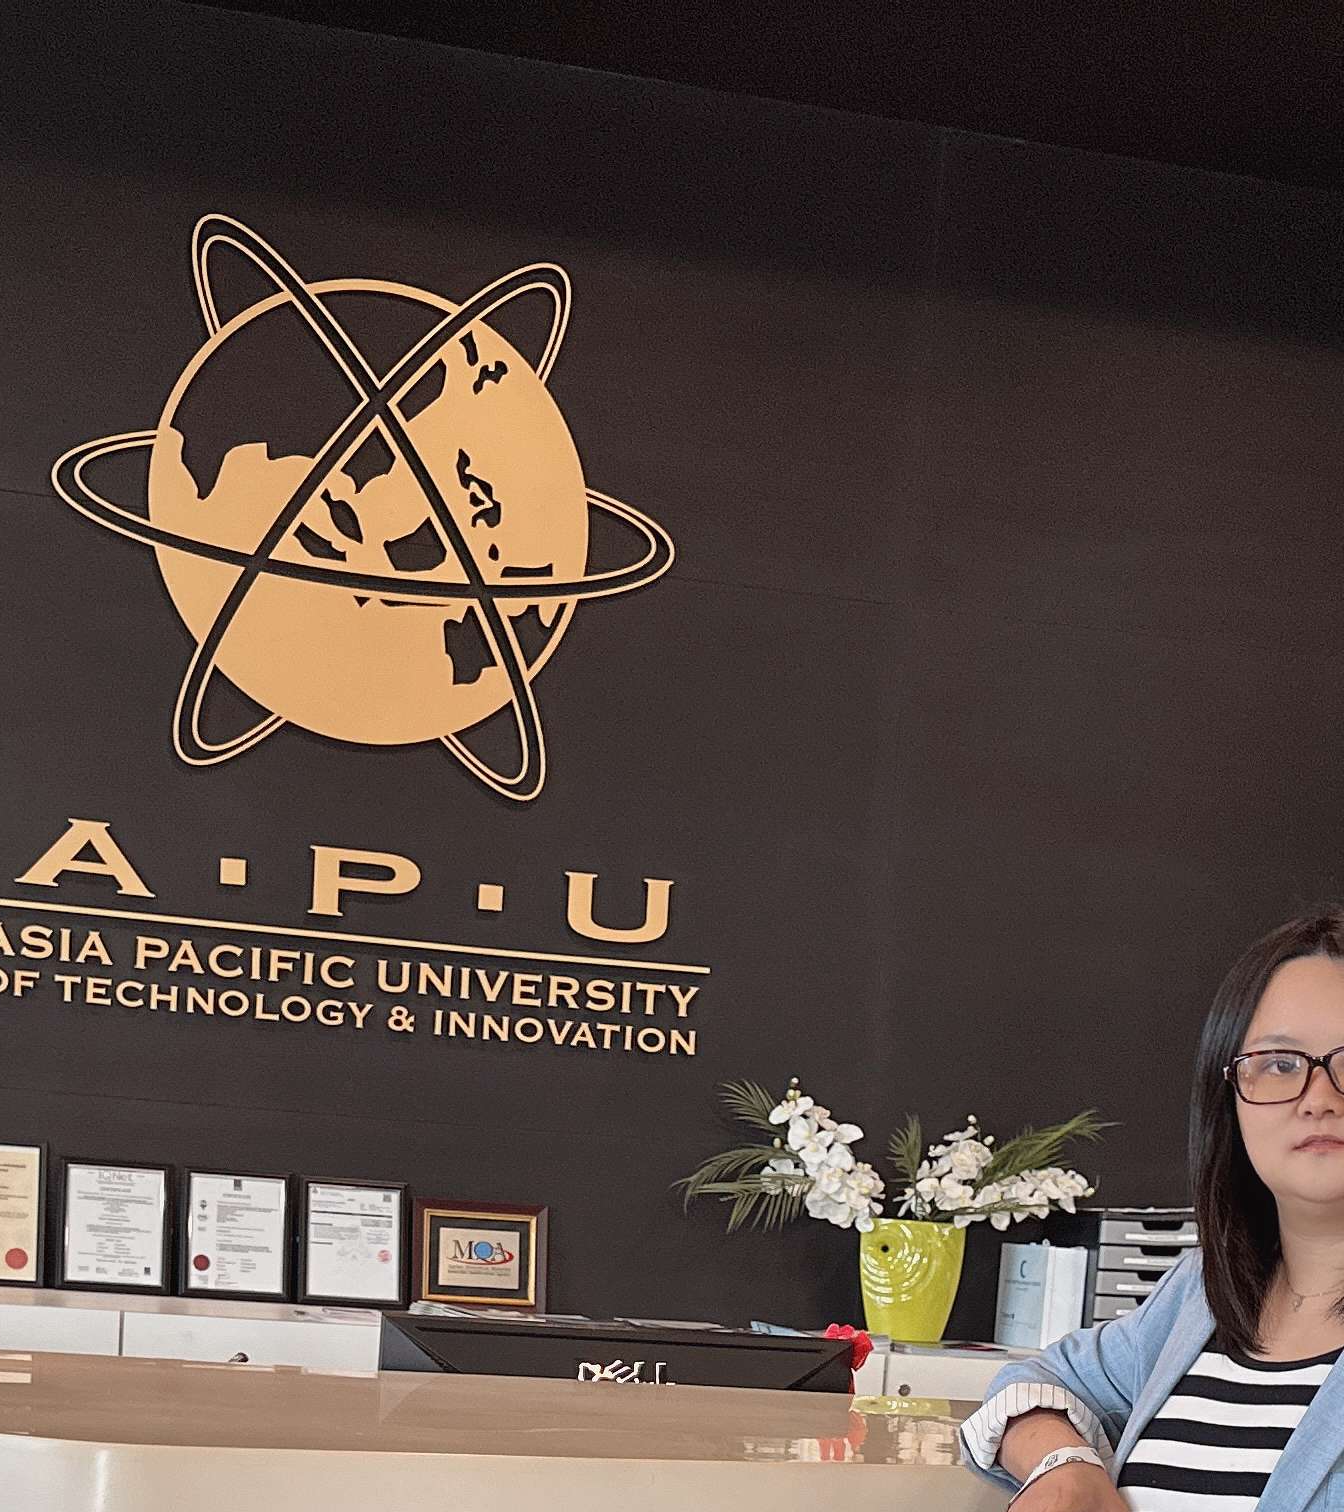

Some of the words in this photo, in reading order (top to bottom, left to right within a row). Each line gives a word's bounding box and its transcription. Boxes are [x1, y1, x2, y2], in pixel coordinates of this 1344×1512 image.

[54, 974, 374, 1029] TECHNOLOGY
[387, 1005, 415, 1033] &
[433, 1009, 697, 1056] INNOVATION
[134, 935, 356, 989] PACIFIC
[377, 959, 700, 1018] UNIVERSITY
